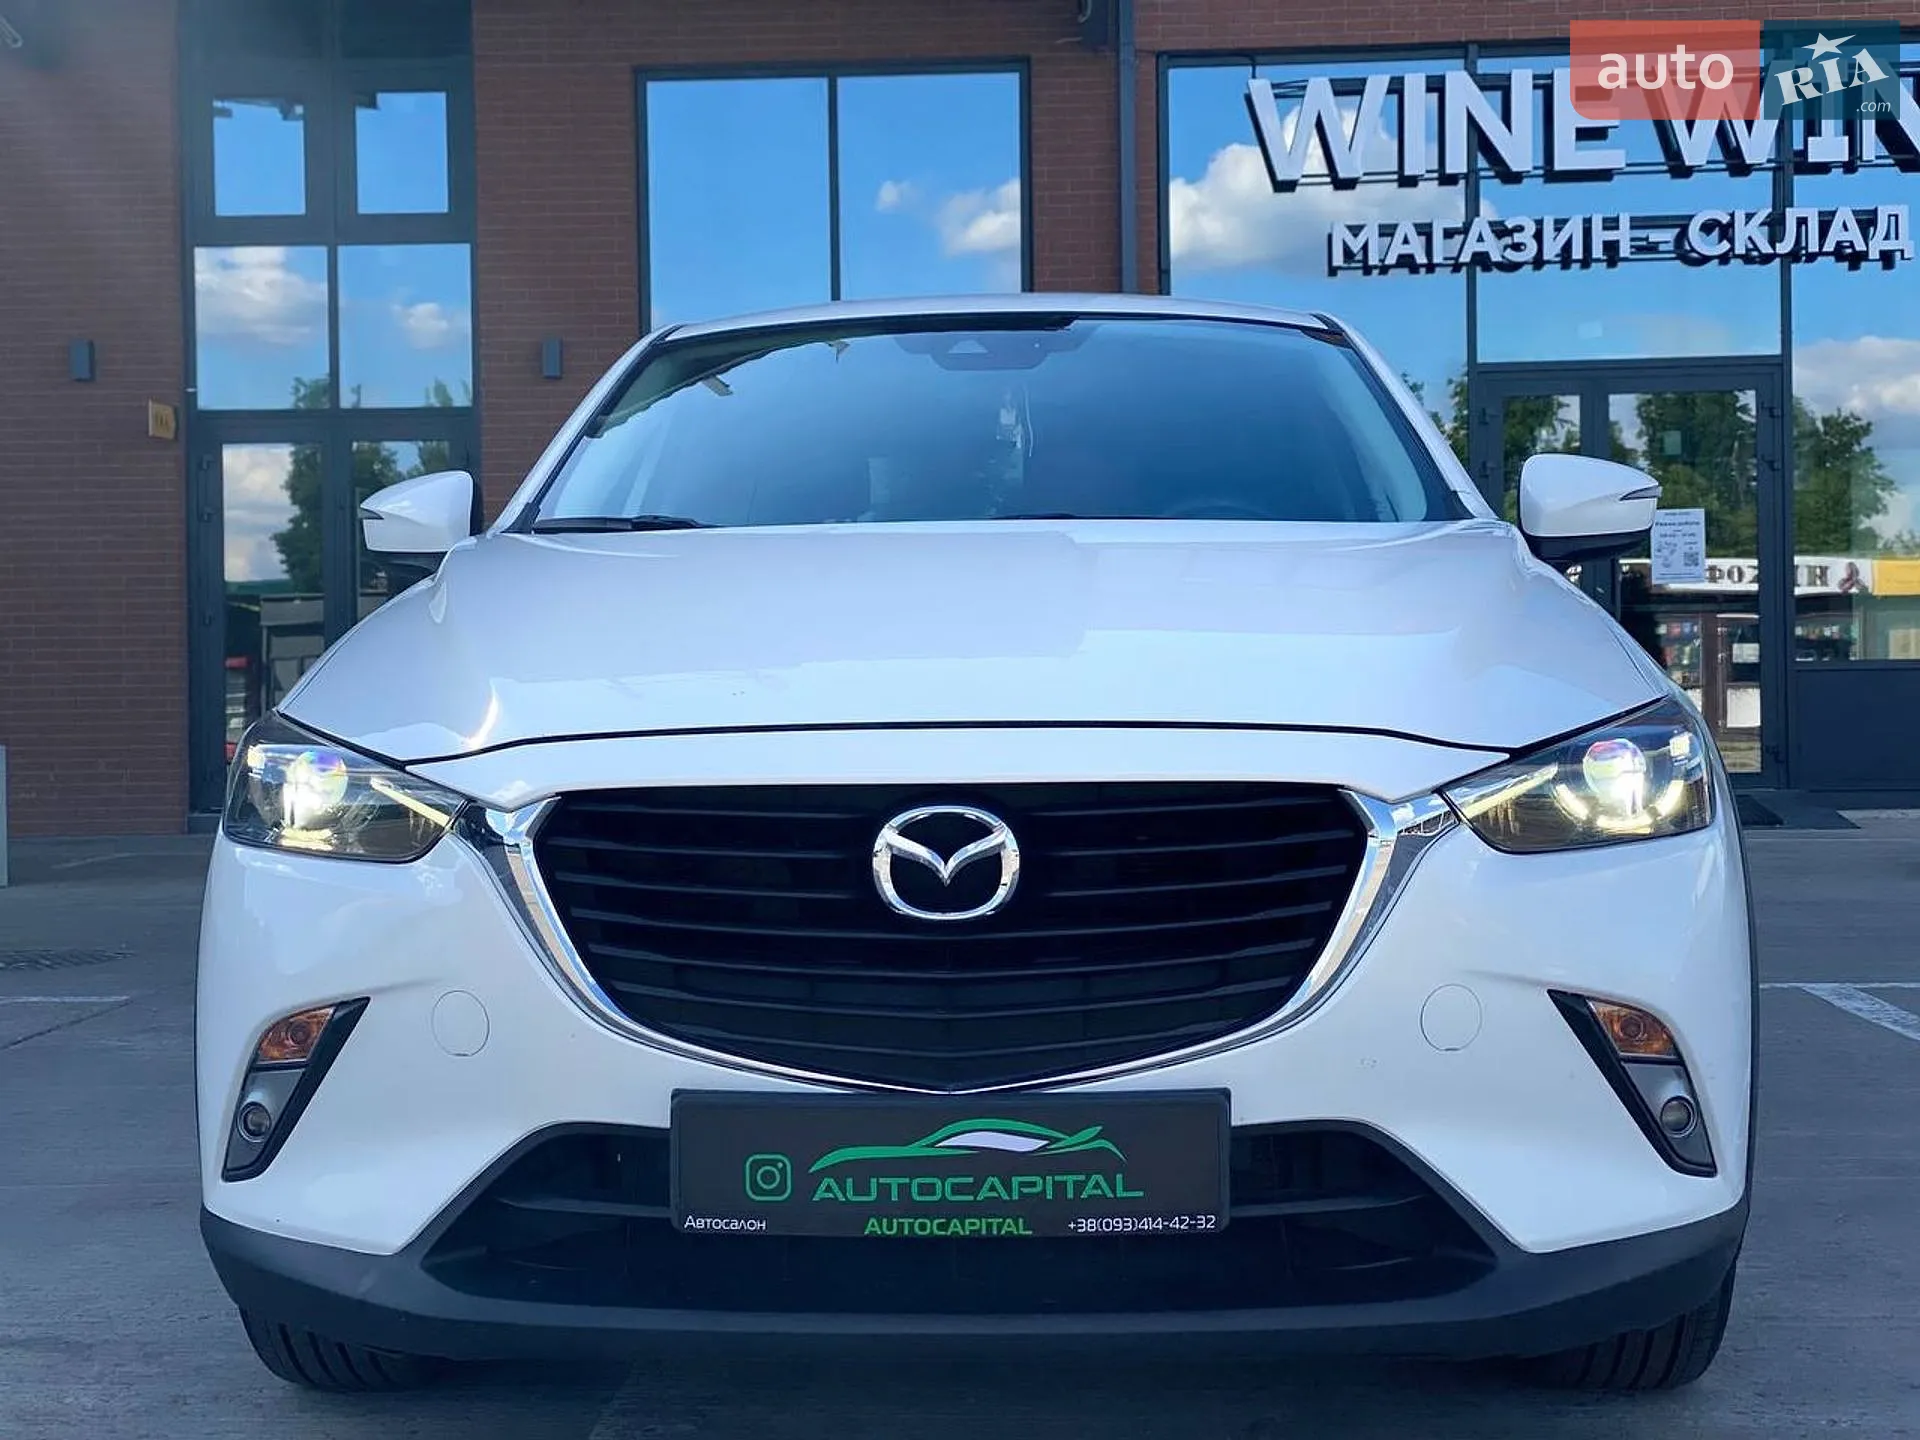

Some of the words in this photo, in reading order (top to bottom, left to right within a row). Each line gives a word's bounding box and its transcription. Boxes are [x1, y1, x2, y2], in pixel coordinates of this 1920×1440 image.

[1246, 66, 1626, 183] WINE
[1330, 212, 1632, 268] МАГАЗИН
[1687, 204, 1915, 260] СКЛАД
[812, 1173, 1145, 1201] AUTOCAPITAL
[684, 1215, 766, 1231] Автосалон
[864, 1217, 1033, 1236] AUTOCAPITAL
[1067, 1215, 1216, 1233] +38(093)414-42-32
